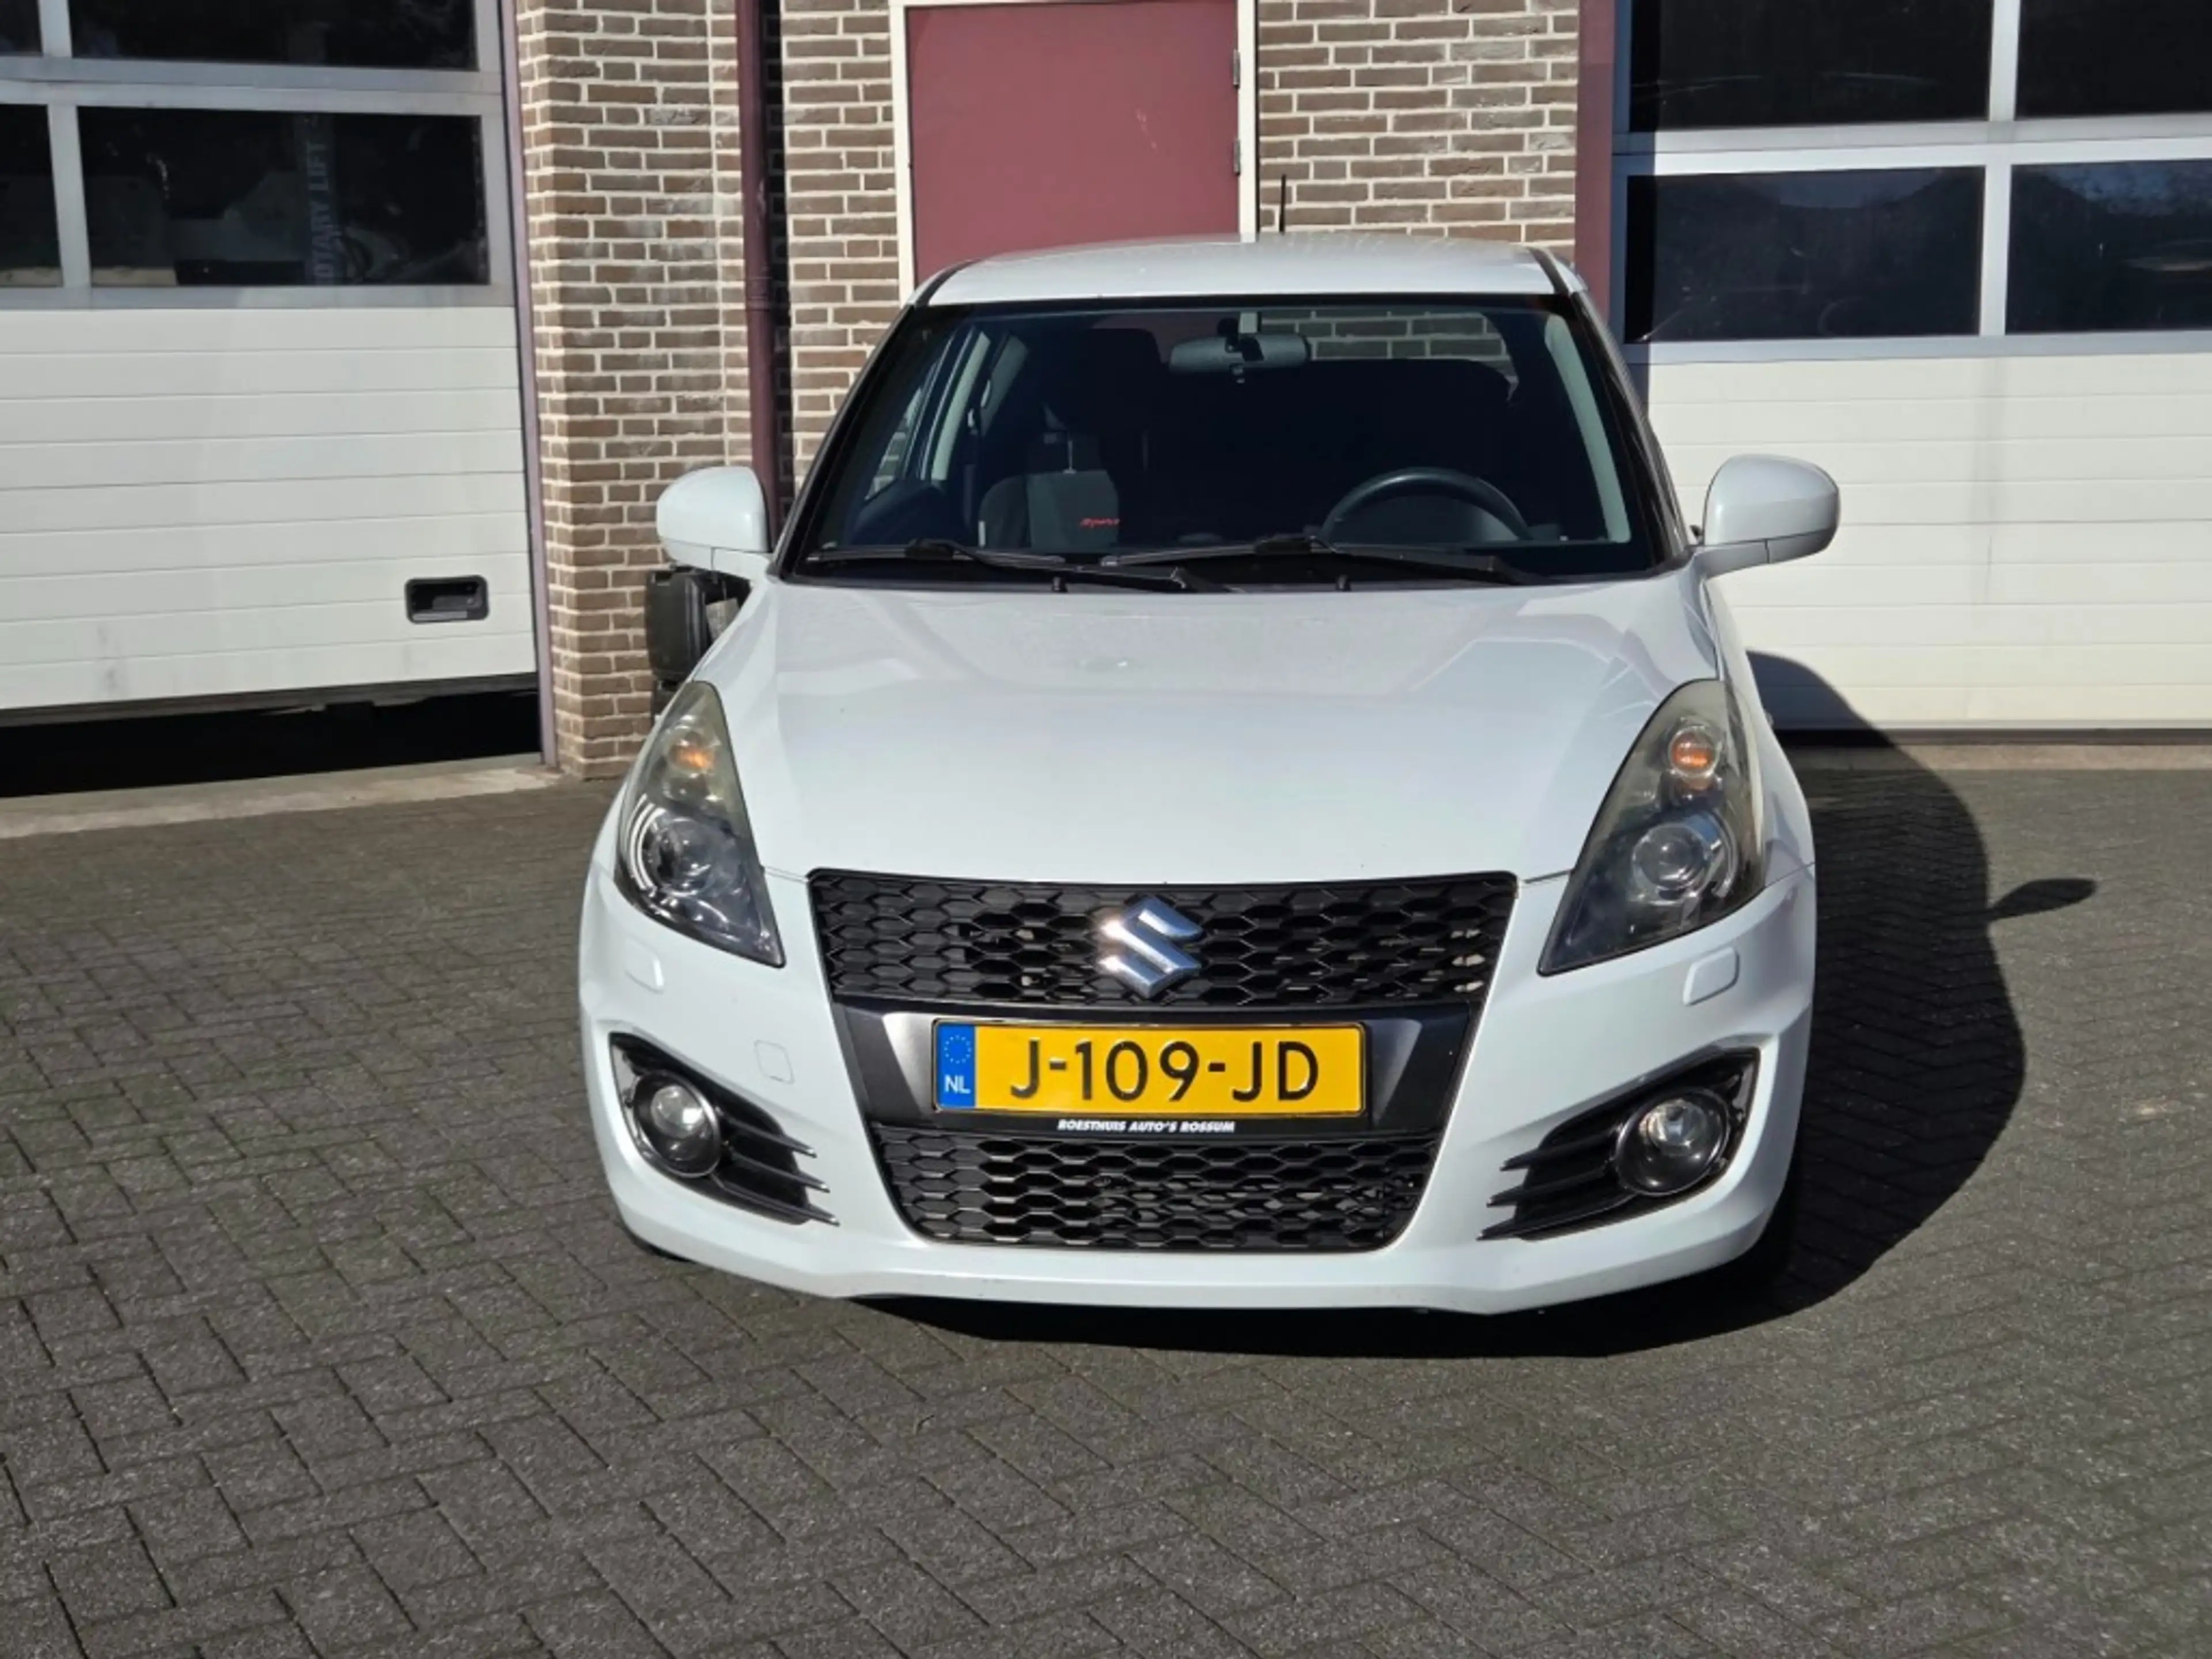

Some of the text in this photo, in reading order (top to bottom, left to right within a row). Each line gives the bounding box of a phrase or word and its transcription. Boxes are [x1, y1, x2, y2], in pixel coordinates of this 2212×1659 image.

[306, 142, 329, 191] LIFT
[944, 1074, 971, 1094] NL
[1010, 1039, 1319, 1103] J-109-JD
[1057, 1119, 1236, 1134] ROESTHUIS AUTO'S ROSSUM
